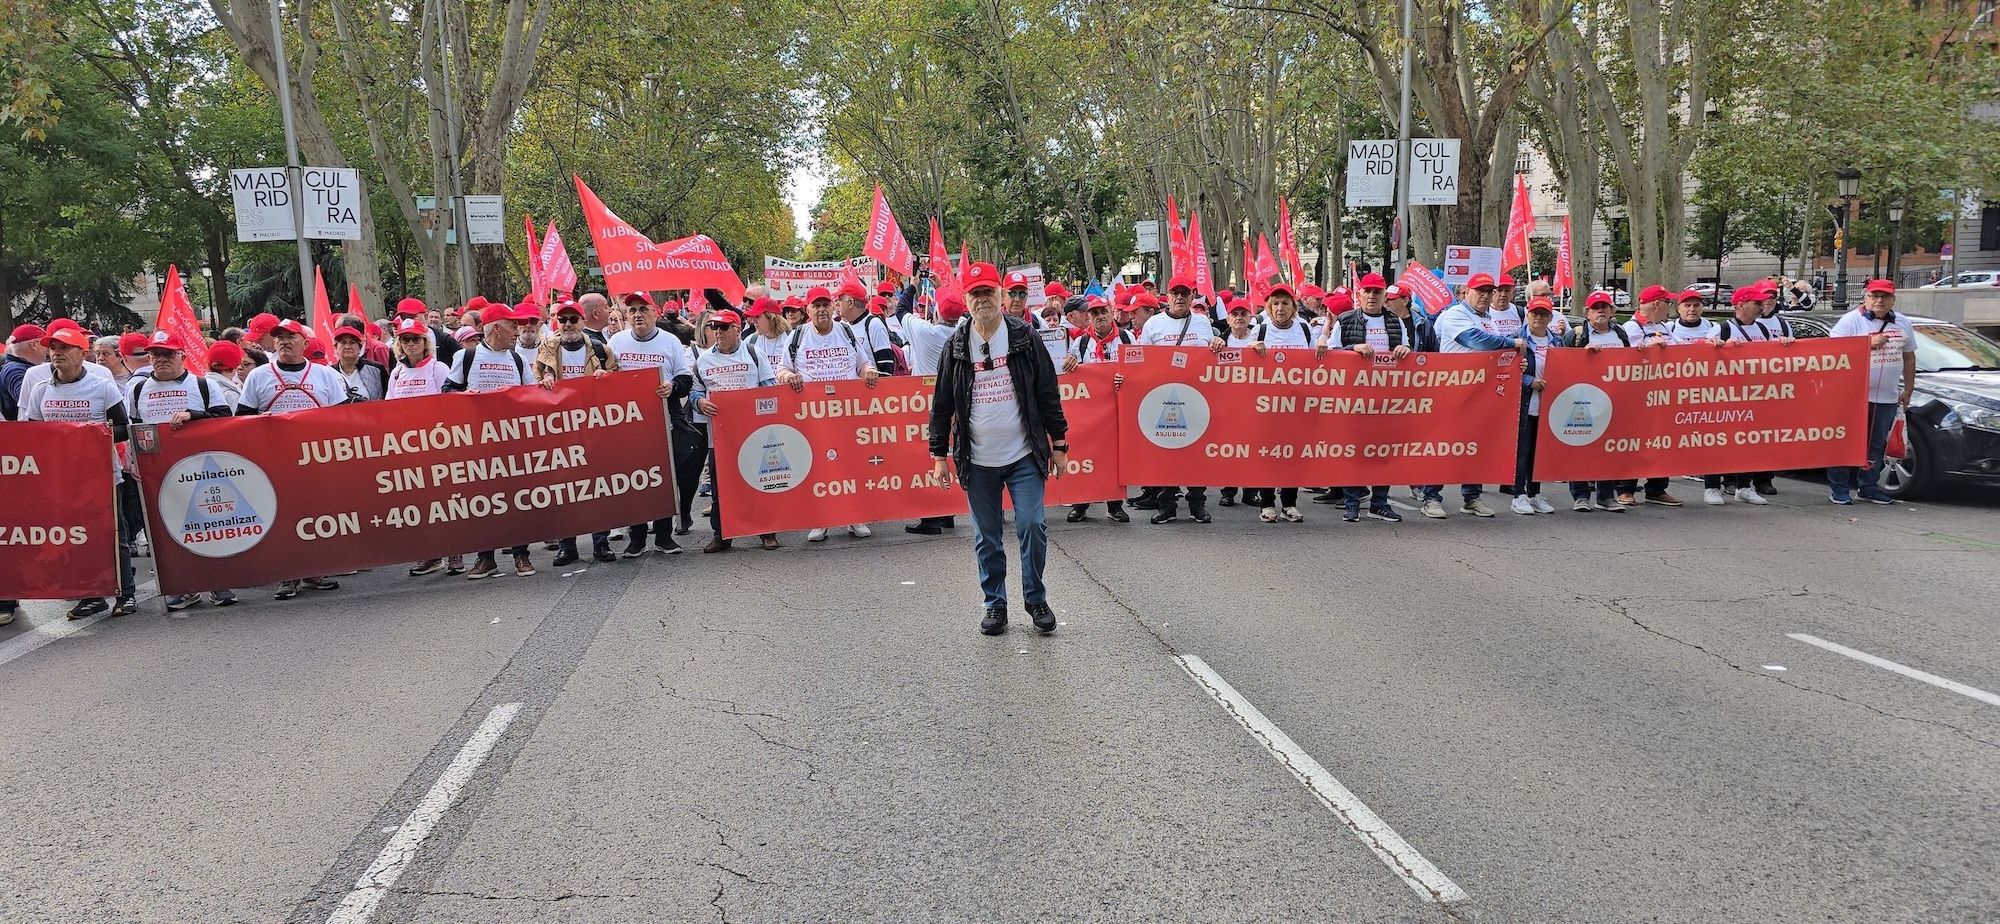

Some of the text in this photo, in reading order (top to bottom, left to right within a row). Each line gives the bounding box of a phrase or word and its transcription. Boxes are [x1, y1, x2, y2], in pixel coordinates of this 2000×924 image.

[1351, 144, 1394, 159] MAD
[1414, 142, 1450, 158] CUL
[1366, 161, 1393, 175] RID
[1420, 159, 1444, 174] TU
[233, 172, 287, 190] MAD
[305, 171, 347, 188] CUL
[1350, 176, 1371, 193] ES
[1433, 176, 1455, 191] RA
[254, 190, 289, 207] RID
[312, 189, 340, 205] TU
[239, 208, 264, 226] ES
[328, 207, 357, 224] RA
[604, 261, 633, 276] CON
[636, 259, 652, 271] 40
[656, 255, 690, 270] AÑOS
[770, 270, 790, 278] PARA
[803, 270, 832, 279] PUEBLO
[620, 353, 664, 362] ASJUBI40
[806, 348, 848, 358] ASJUBI40
[1220, 352, 1240, 360] NO+
[1375, 355, 1396, 363] NO+
[1199, 365, 1487, 388] JUBILACIÓN ANTICIPADA
[1601, 353, 1852, 383] JUBILACIÓN ANTICIPADA
[150, 391, 186, 399] ASJUBI40
[1646, 383, 1795, 408] SIN PENALIZAR
[45, 400, 89, 408] ASJUBI40
[1255, 395, 1434, 415] SIN PENALIZAR
[1674, 410, 1754, 425] CATALUNYA
[298, 400, 644, 466] JUBILACIÓN ANTICIPADA
[856, 425, 897, 446] SIN
[1604, 425, 1847, 453] CON +40 AÑOS COTIZADOS
[1205, 440, 1478, 459] CON +40 AÑOS COTIZADOS
[178, 468, 245, 483] Jubilación
[375, 444, 588, 495] SIN PENALIZAR
[759, 473, 792, 483] ASJUBI40
[813, 478, 857, 498] CON
[865, 473, 903, 492] +40
[208, 503, 234, 514] 100 %
[295, 465, 664, 541] CON +40 AÑOS COTIZADOS
[184, 515, 257, 531] sin penalizar
[183, 525, 263, 544] ASJUBI40
